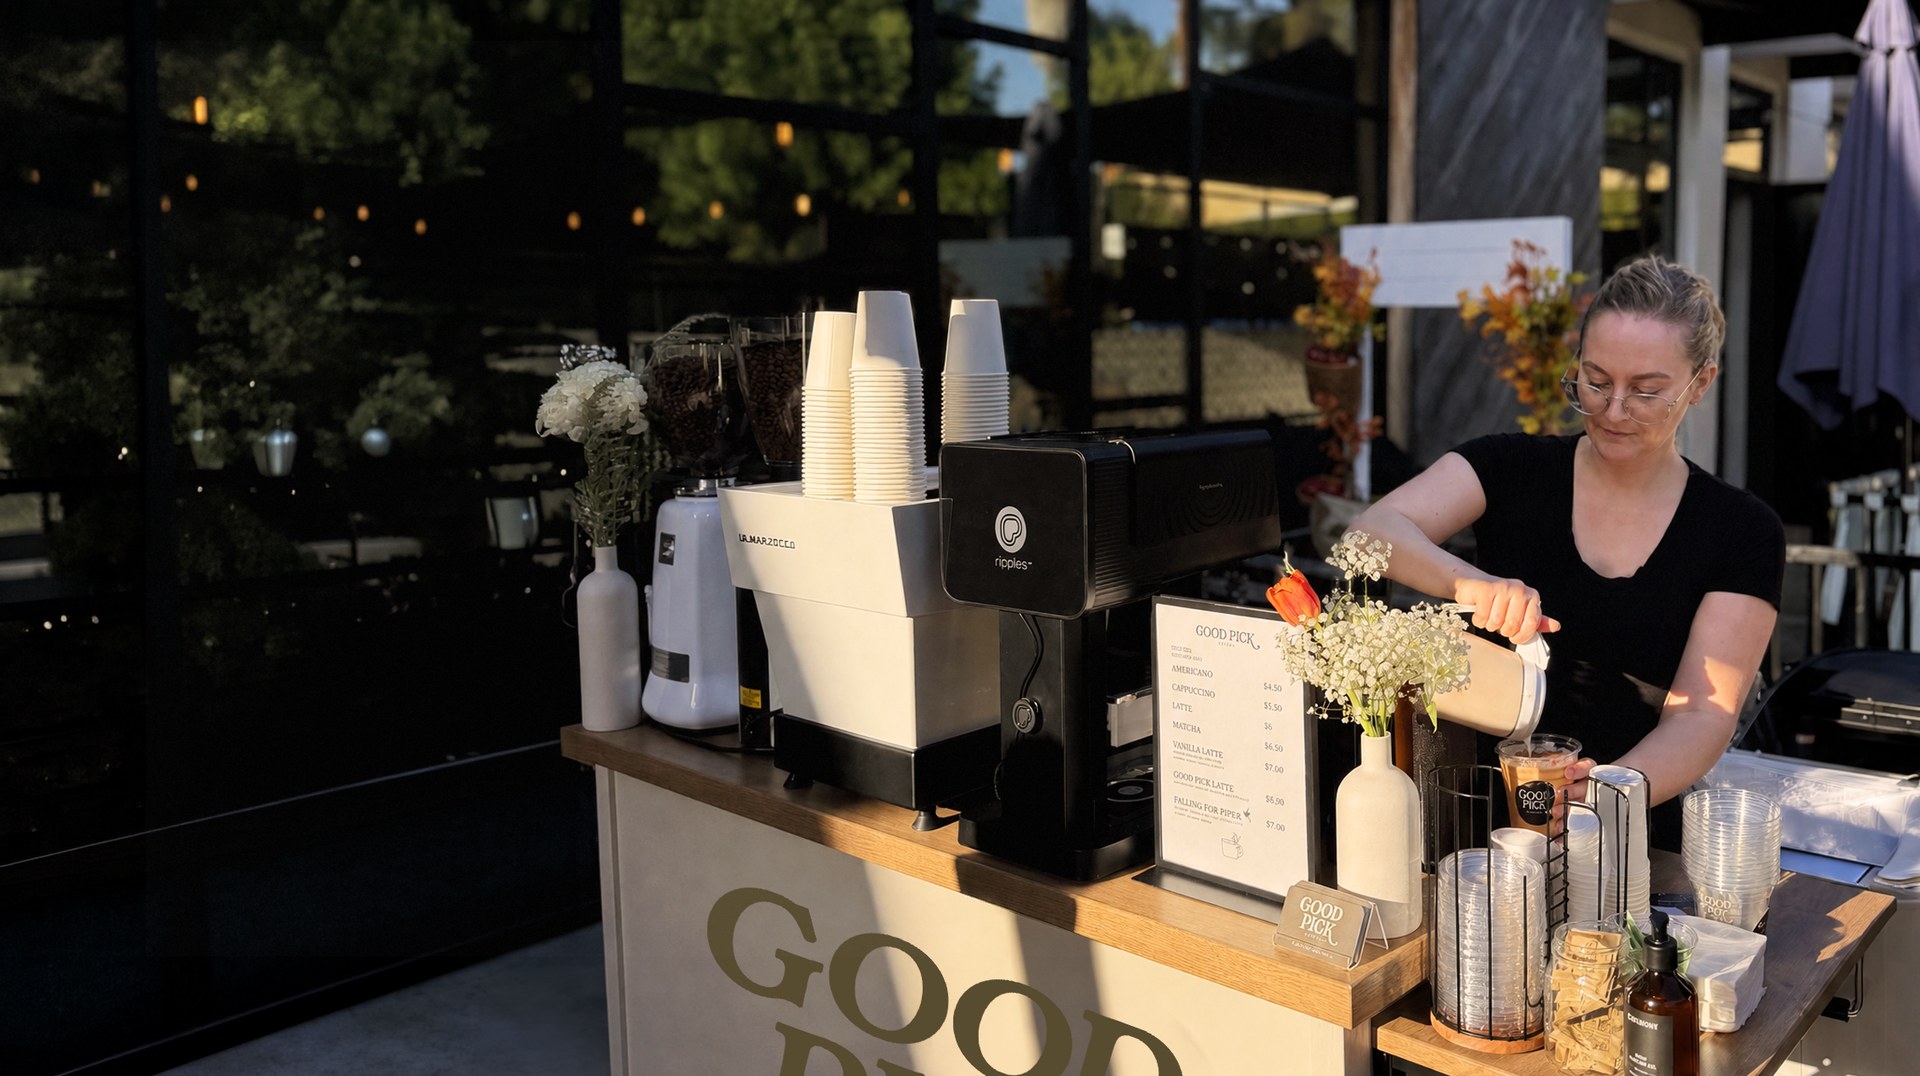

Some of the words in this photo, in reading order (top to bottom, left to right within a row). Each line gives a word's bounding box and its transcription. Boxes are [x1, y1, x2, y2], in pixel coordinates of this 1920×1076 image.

[1196, 625, 1227, 640] GOOD
[1230, 631, 1260, 650] PICK
[1172, 665, 1213, 678] AMERICANO
[1172, 683, 1216, 698] CAPPUCCINO
[1263, 682, 1282, 693] $4.50
[1172, 702, 1193, 713] LATTE
[1264, 702, 1283, 712] $5.50
[1172, 721, 1201, 734] MATCHA
[1264, 722, 1272, 731] $6
[1173, 740, 1200, 754] VANILLA
[1202, 747, 1223, 759] LATTE
[1264, 742, 1284, 753] $6.50
[1265, 763, 1284, 774] $7.00
[1173, 771, 1194, 782] GOOD
[1195, 776, 1211, 787] PICK
[1212, 780, 1235, 793] LATTE
[1174, 795, 1202, 810] FALLING
[1204, 803, 1218, 815] FOR
[1220, 808, 1242, 820] PIPER
[1266, 820, 1285, 832] $7.00
[1300, 896, 1343, 922] GOOD
[1299, 913, 1338, 946] PICK
[707, 887, 1183, 1076] GOOD
